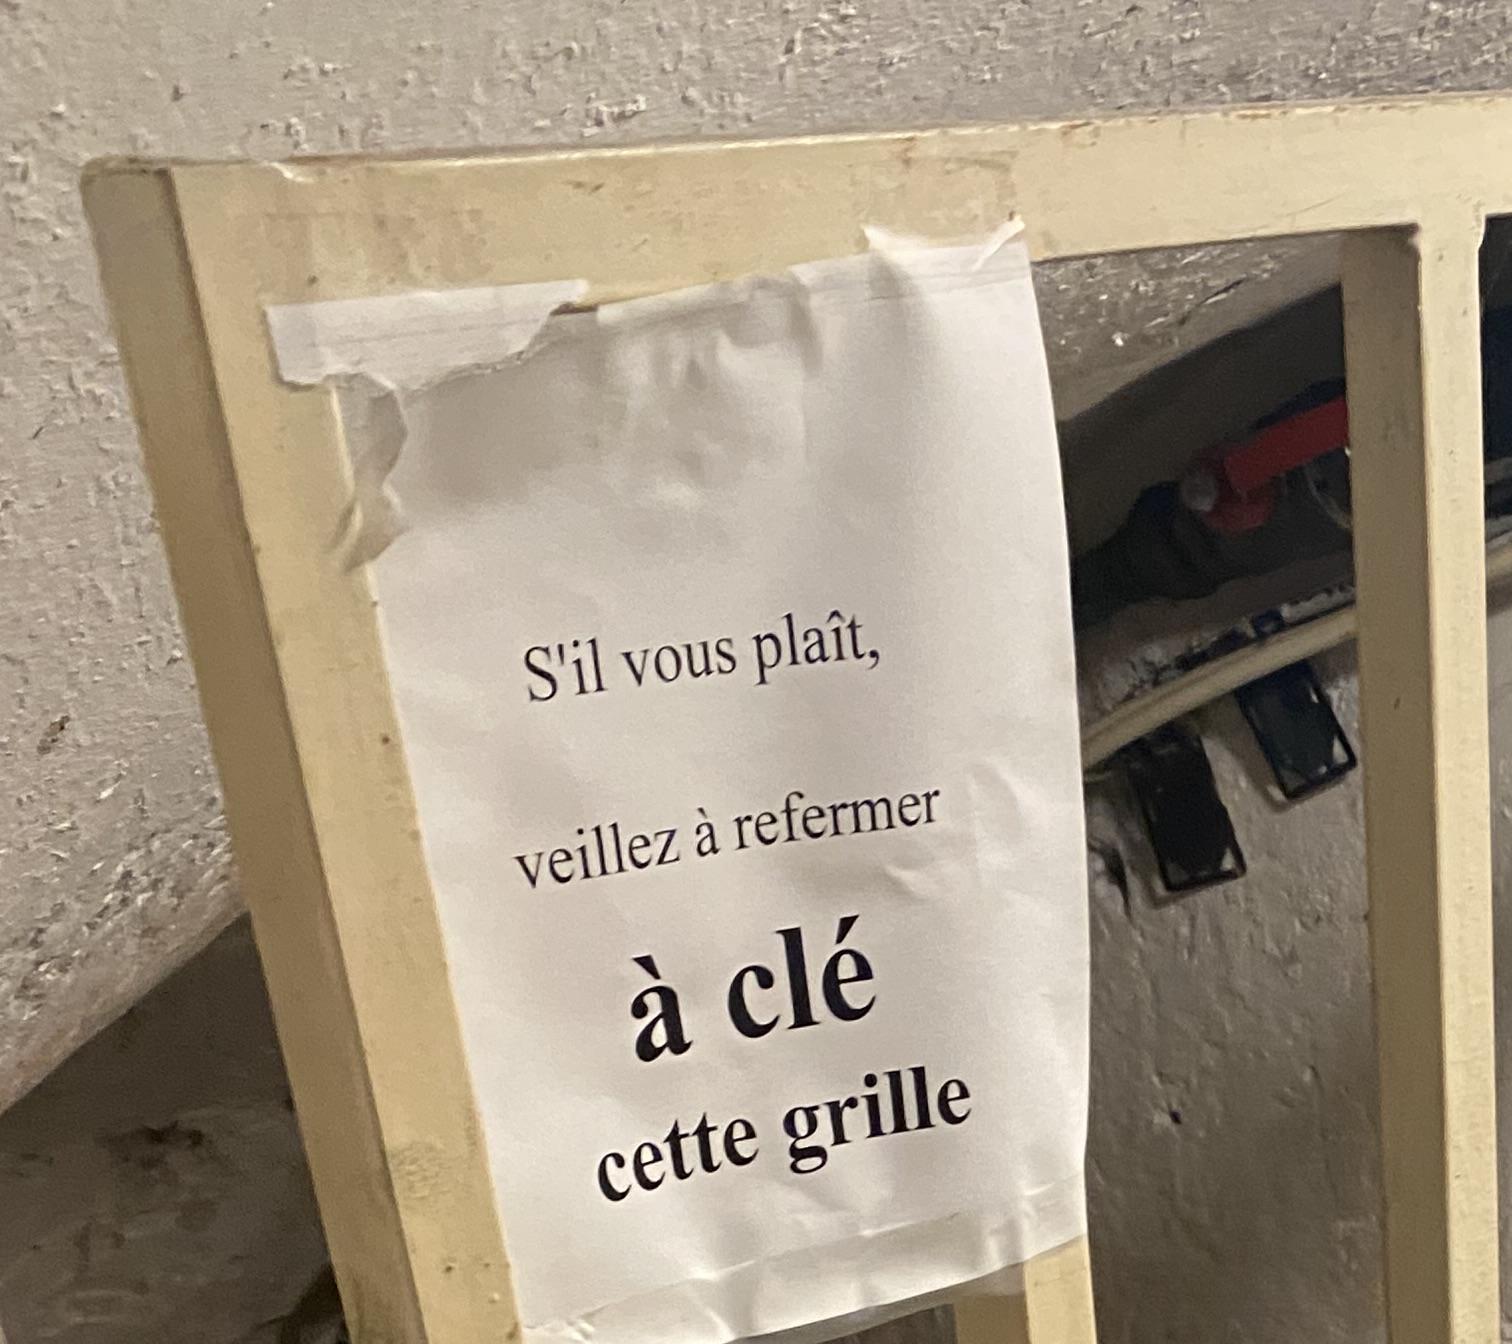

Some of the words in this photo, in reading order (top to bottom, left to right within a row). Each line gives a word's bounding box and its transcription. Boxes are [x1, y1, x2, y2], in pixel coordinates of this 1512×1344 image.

[521, 637, 608, 703] S'il
[620, 634, 738, 687] vous
[750, 609, 881, 687] plaît,
[513, 822, 679, 889] veillez
[694, 806, 721, 857] à
[734, 789, 941, 852] refermer
[629, 954, 694, 1063] à
[726, 914, 877, 1039] clé
[596, 1111, 760, 1203] cette
[781, 1065, 972, 1175] grille
